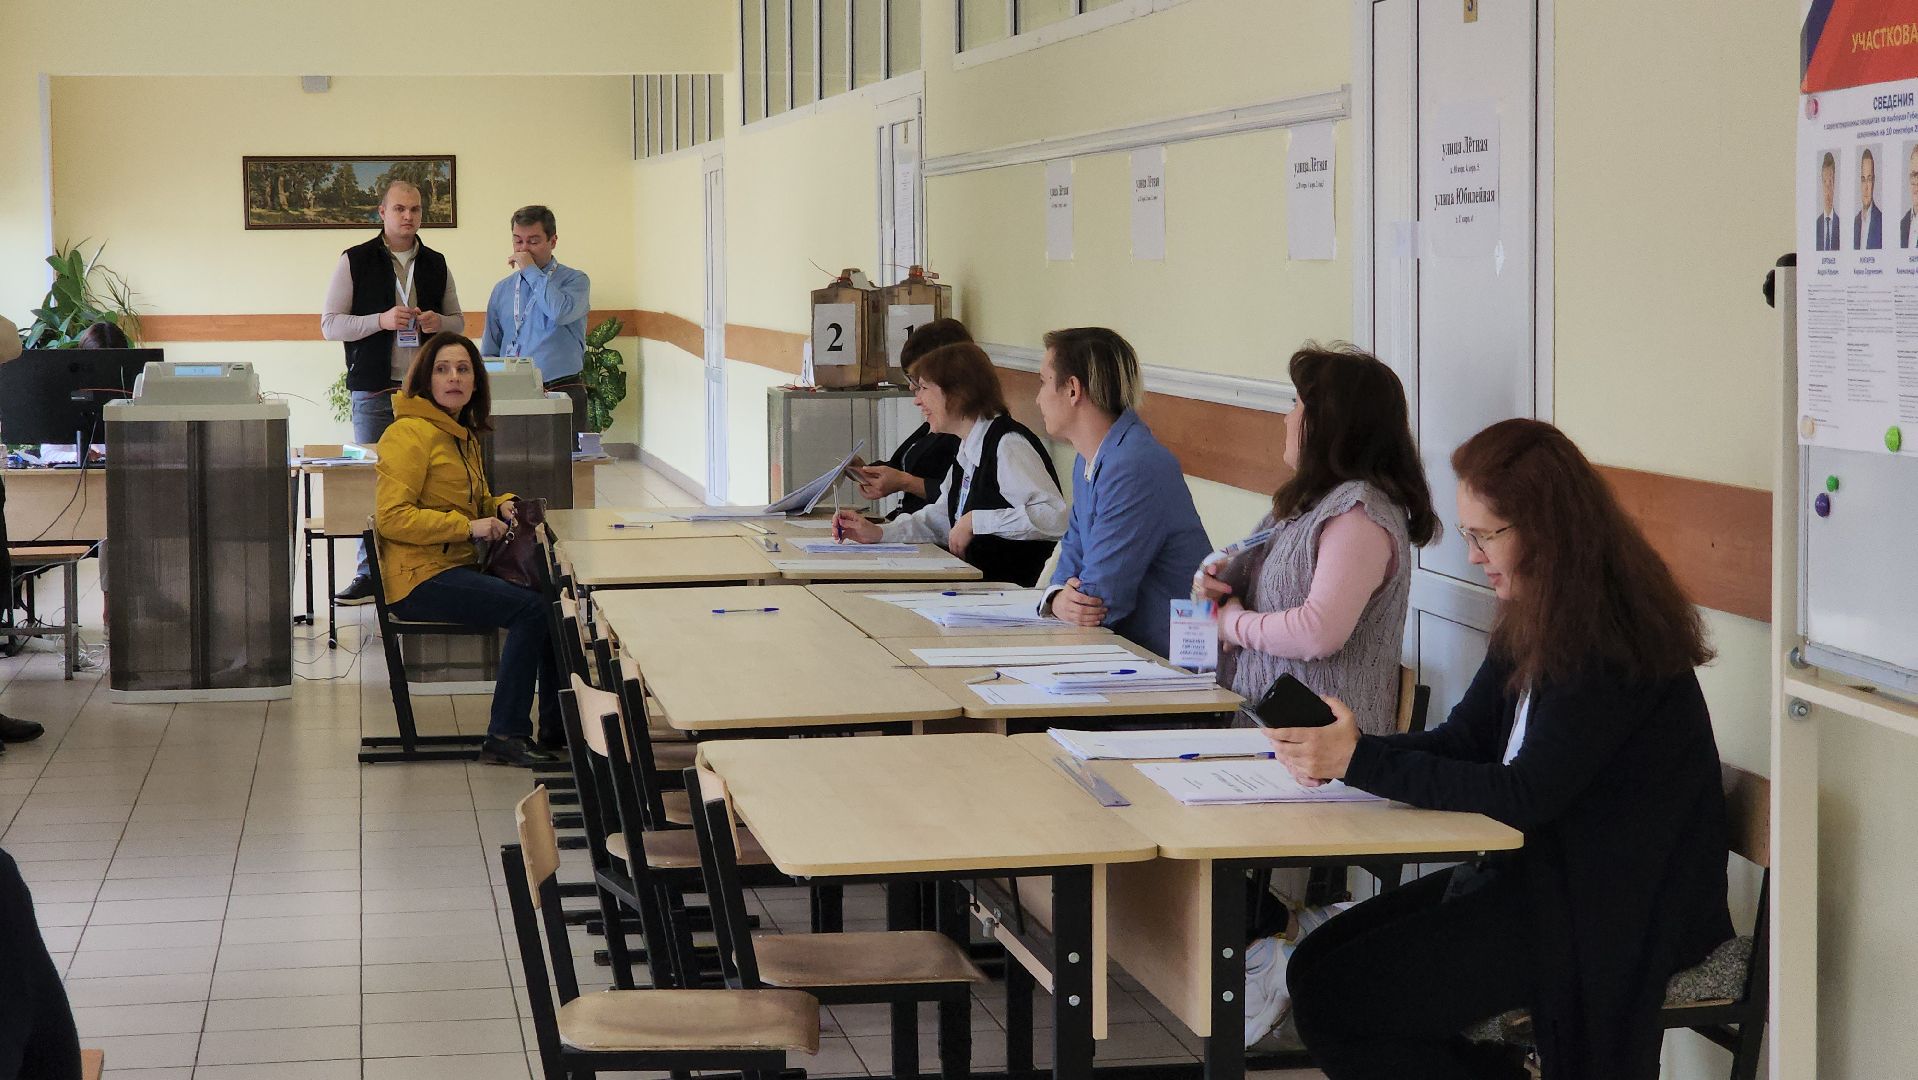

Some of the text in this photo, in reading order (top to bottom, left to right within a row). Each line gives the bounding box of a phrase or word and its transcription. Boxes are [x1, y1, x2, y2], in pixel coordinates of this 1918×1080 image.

[1873, 93, 1914, 111] СВЕДЕНИЯ
[1442, 143, 1462, 161] улица
[1434, 186, 1495, 211] улица Юбилейная
[826, 322, 844, 352] 2
